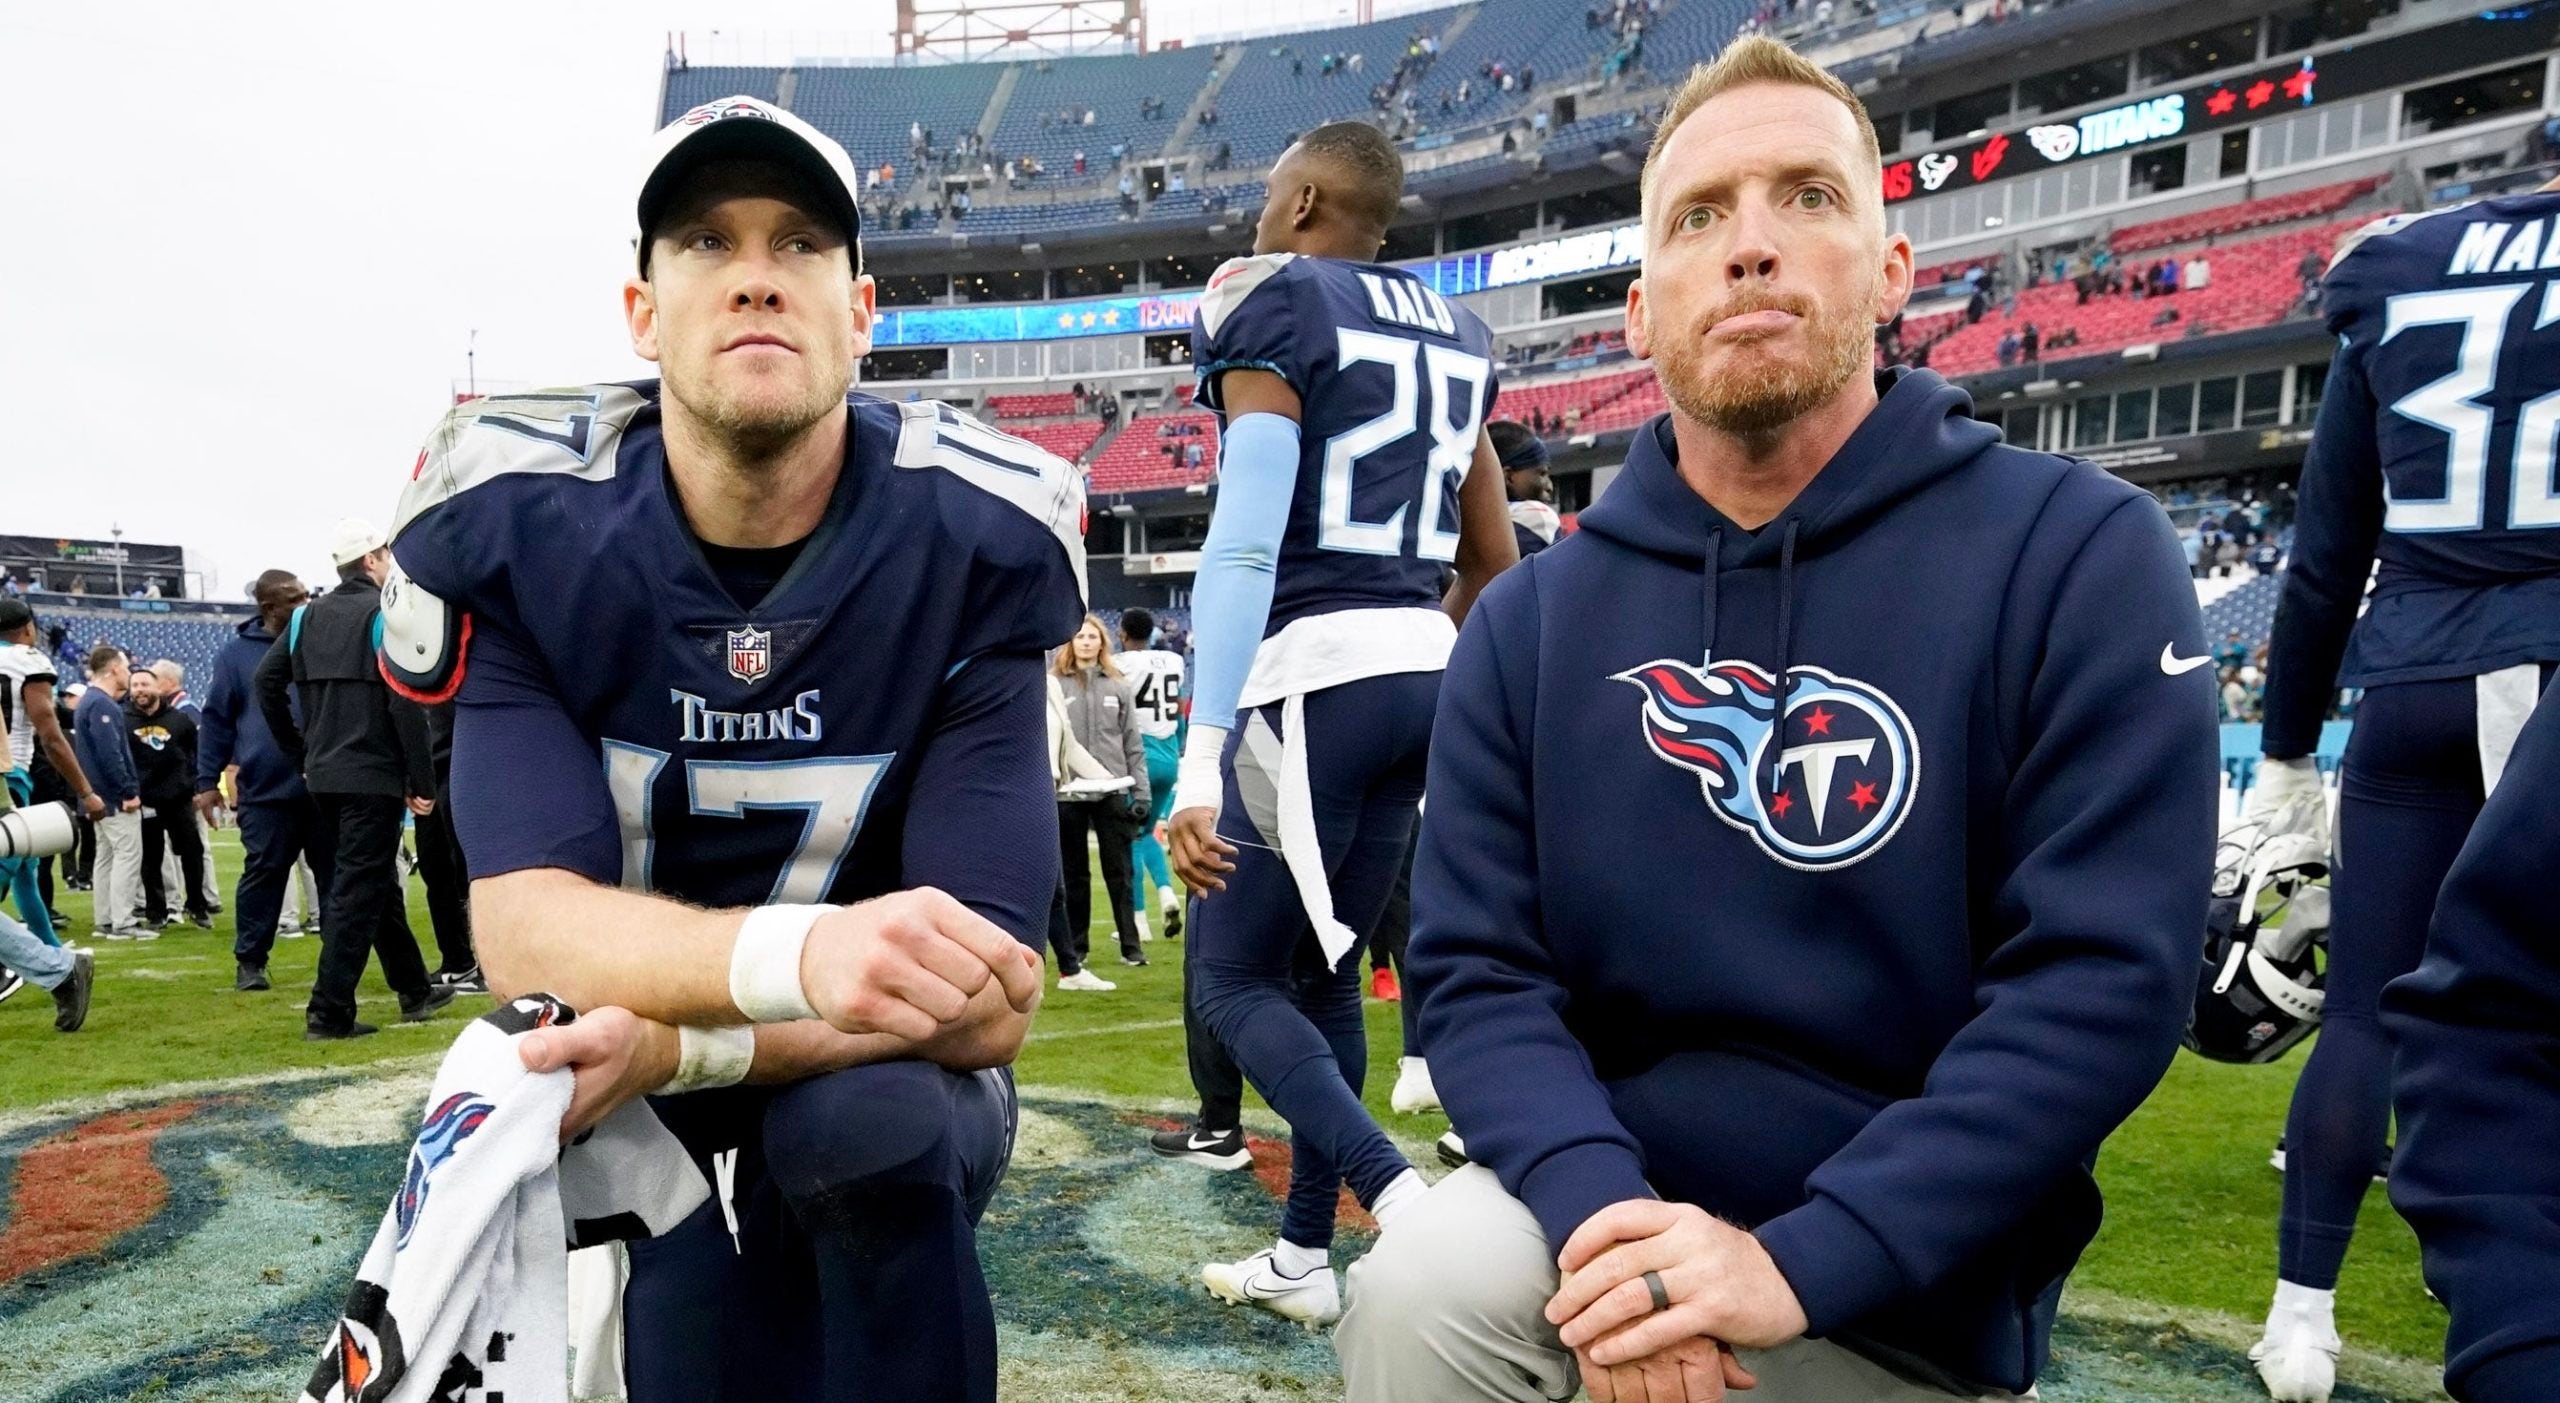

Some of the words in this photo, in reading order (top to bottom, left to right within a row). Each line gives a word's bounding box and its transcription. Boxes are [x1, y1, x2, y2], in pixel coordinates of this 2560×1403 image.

[2079, 95, 2184, 154] TITANS
[1358, 272, 1456, 335] KALU
[1317, 326, 1490, 563] 28
[735, 651, 764, 673] NFL
[670, 687, 822, 742] TITANS
[1135, 672, 1179, 722] 49
[601, 736, 897, 905] 17
